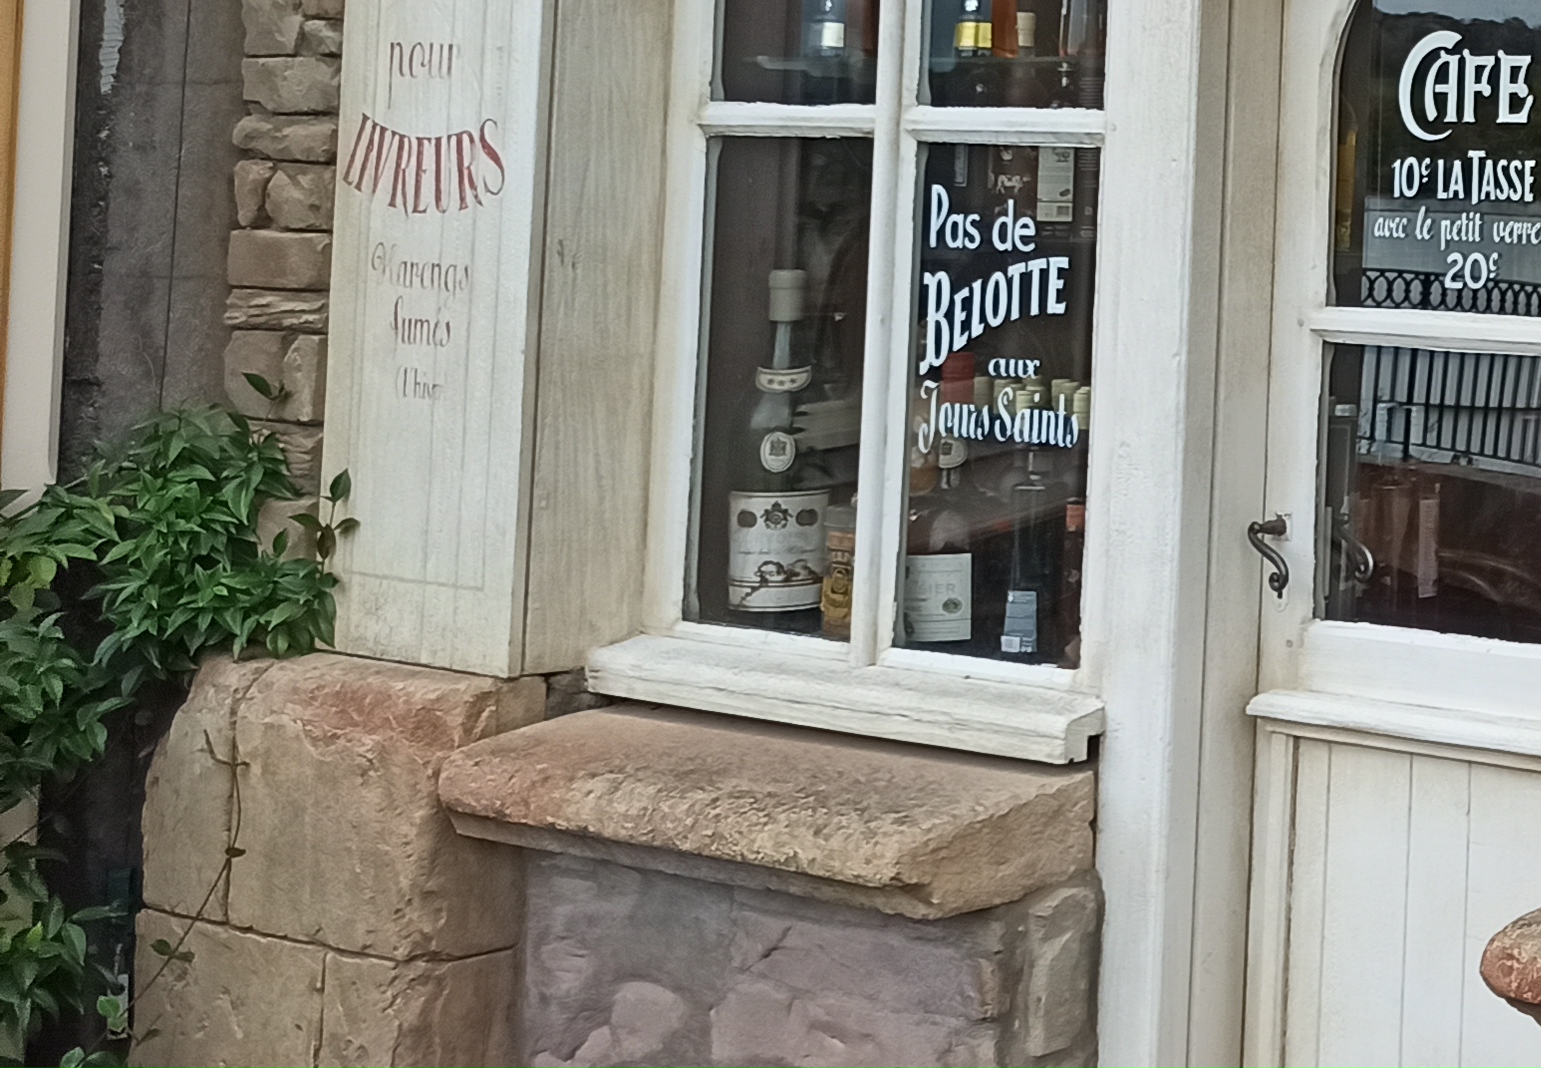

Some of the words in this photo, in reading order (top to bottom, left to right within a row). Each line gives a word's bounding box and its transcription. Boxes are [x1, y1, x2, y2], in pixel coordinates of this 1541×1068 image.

[387, 42, 461, 110] pour
[342, 112, 506, 219] LIVREURS
[1437, 159, 1465, 200] LA
[1467, 150, 1537, 206] TASSE
[928, 183, 982, 250] Pas
[991, 199, 1037, 253] de
[1373, 216, 1408, 238] avec
[1415, 206, 1433, 240] le
[1440, 211, 1484, 251] petit
[919, 256, 1070, 376] BELOTTE
[987, 357, 1041, 379] aux
[917, 380, 991, 454] Jours
[994, 386, 1079, 449] Saints
